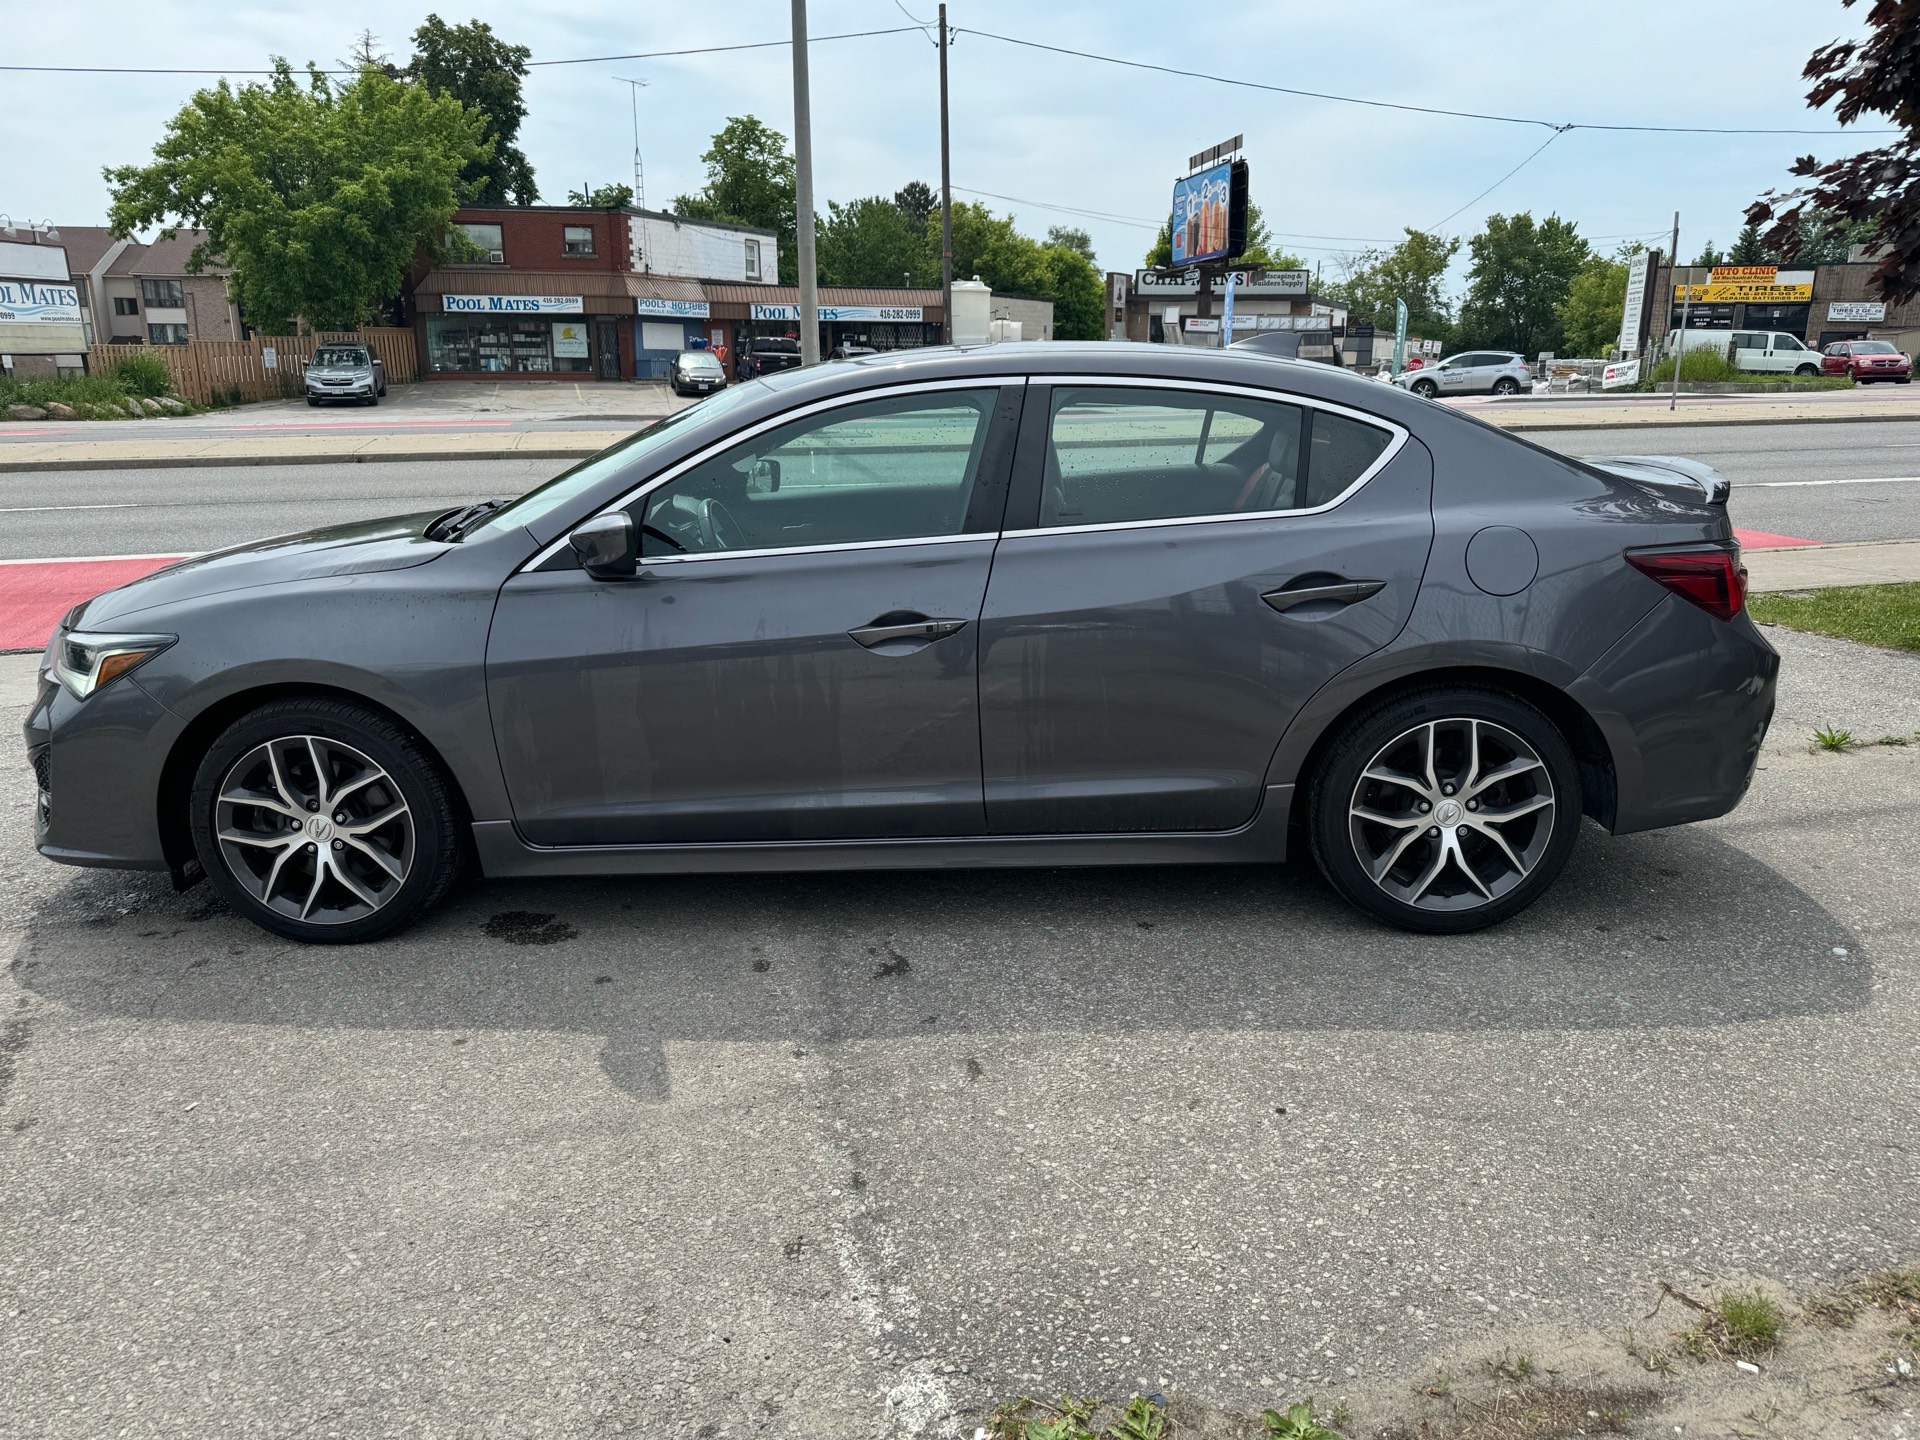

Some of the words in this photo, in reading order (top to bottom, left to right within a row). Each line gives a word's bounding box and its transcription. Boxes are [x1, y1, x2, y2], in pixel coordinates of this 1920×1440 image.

[1712, 267, 1739, 276] AUTO
[1741, 266, 1777, 275] CLINIC
[1281, 280, 1304, 288] Supply
[17, 282, 78, 307] MATES
[445, 296, 485, 310] POOL
[487, 296, 540, 311] MATES
[639, 299, 667, 309] POOLS
[671, 301, 688, 311] HOT
[687, 302, 708, 311] TUBS
[754, 304, 789, 320] POOL
[791, 304, 838, 320] MTES
[879, 308, 922, 320] 416-282-0999
[1409, 362, 1422, 370] STOP
